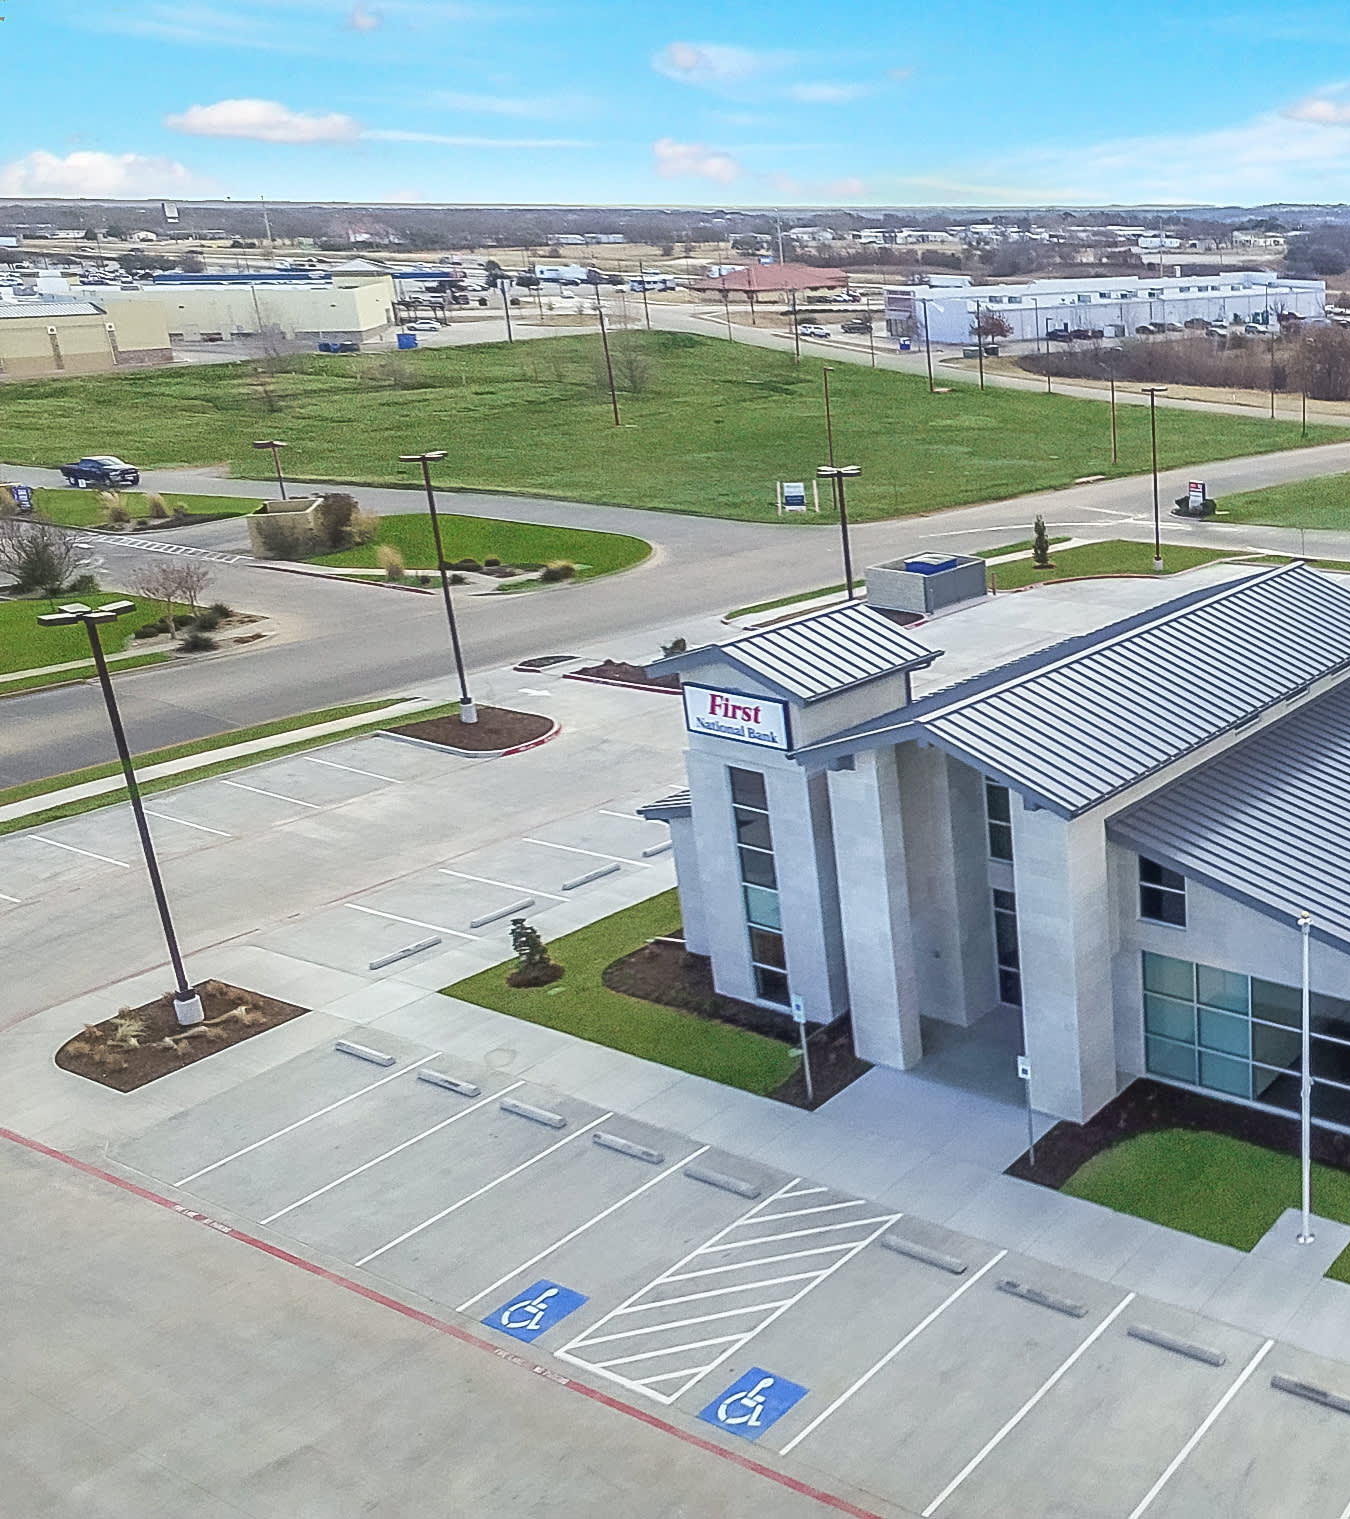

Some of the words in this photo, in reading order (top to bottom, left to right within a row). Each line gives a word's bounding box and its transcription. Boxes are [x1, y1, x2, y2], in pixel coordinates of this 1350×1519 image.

[708, 693, 761, 724] First
[696, 717, 746, 737] National
[747, 727, 778, 743] Bank
